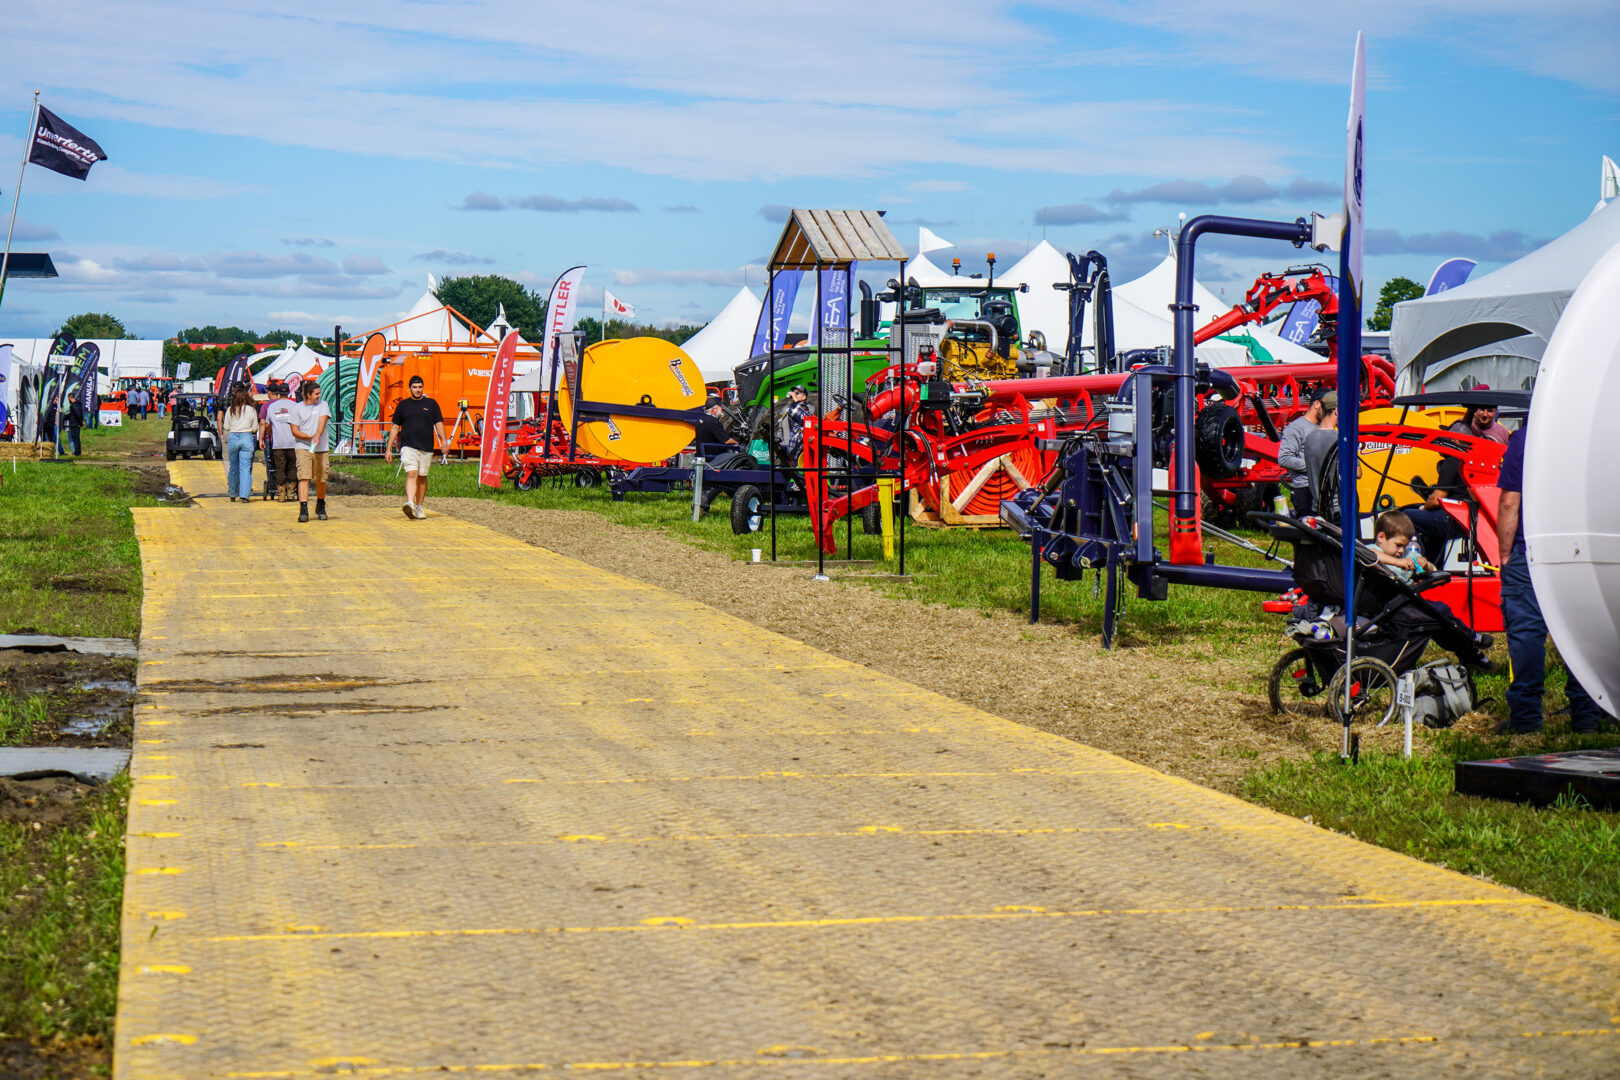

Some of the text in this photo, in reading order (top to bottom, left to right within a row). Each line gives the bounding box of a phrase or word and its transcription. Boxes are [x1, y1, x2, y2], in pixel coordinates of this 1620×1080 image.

[824, 296, 843, 328] EA
[1288, 320, 1310, 342] EA
[70, 346, 91, 376] SEM
